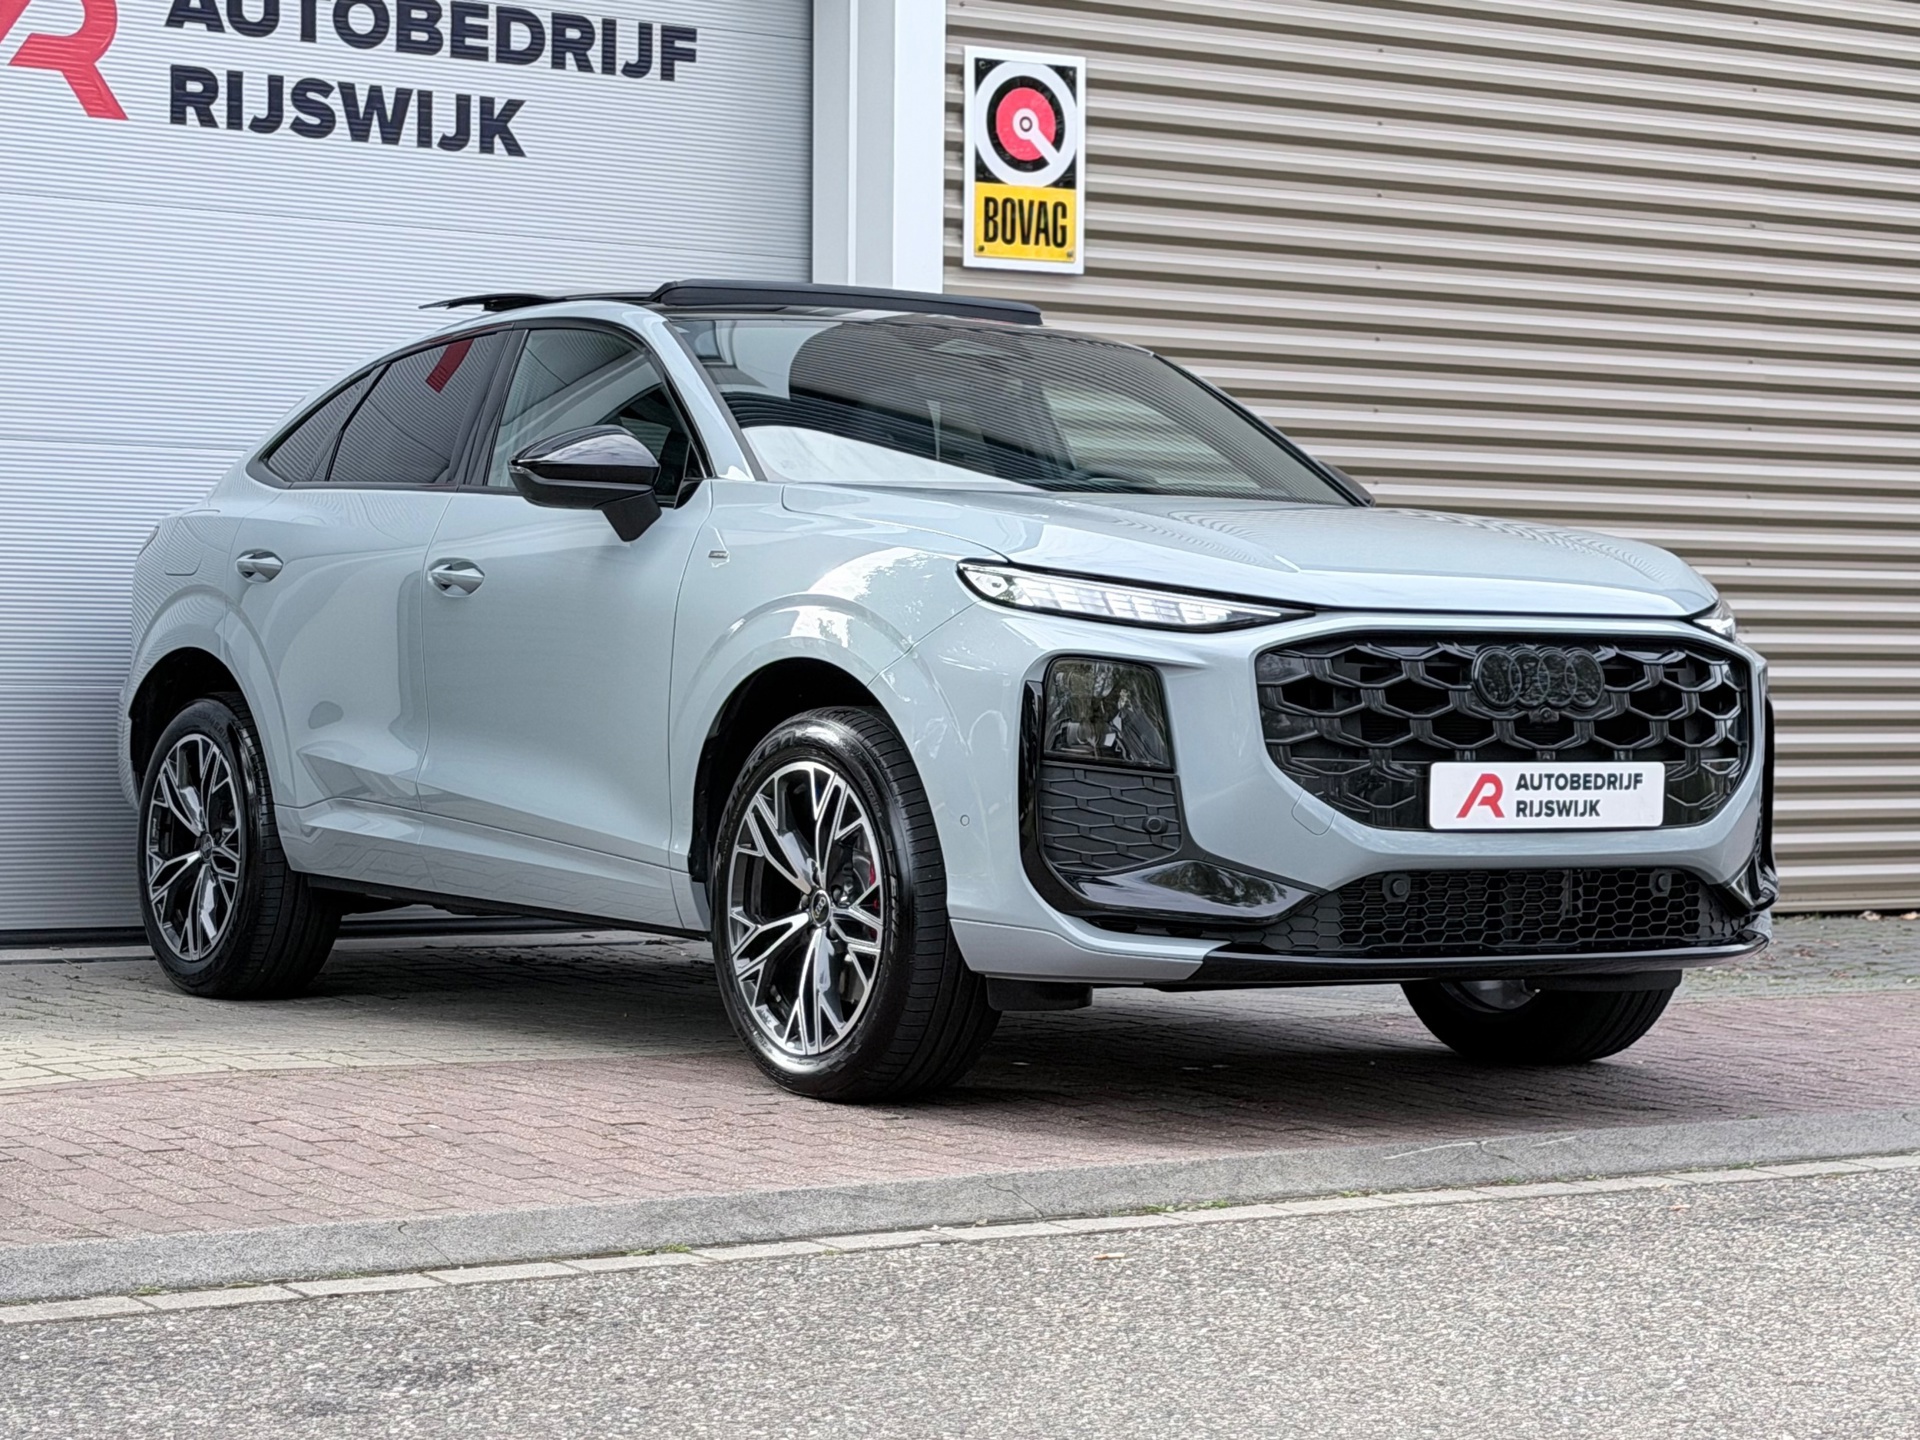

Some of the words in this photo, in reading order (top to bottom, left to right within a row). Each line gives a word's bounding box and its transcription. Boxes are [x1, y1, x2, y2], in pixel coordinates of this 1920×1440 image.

[170, 64, 527, 157] RIJSWIJK
[983, 196, 1067, 248] BOVAG
[1515, 773, 1643, 791] AUTOBEDRIJF
[1515, 799, 1601, 818] RIJSWIJK
